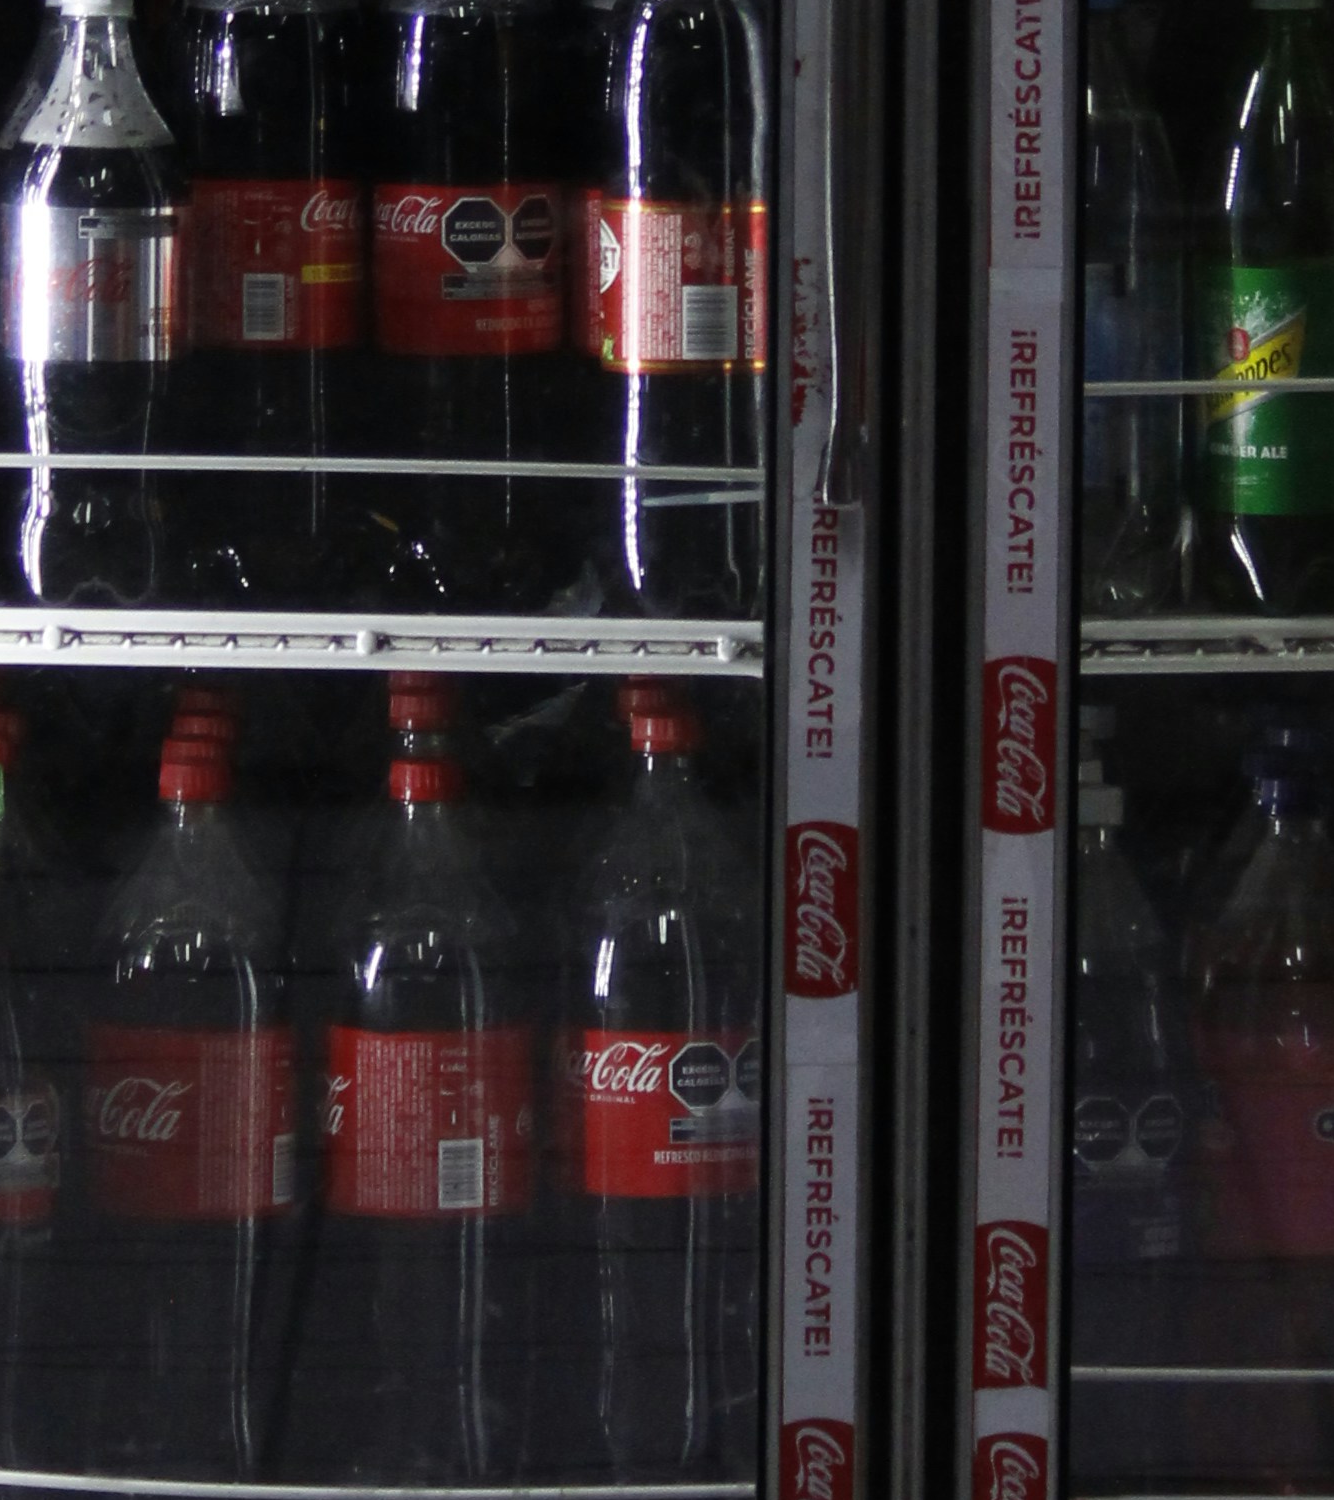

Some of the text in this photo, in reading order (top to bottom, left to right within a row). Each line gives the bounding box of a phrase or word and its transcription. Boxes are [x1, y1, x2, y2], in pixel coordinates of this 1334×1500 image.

[455, 220, 497, 230] EXCESO
[1008, 331, 1038, 593] ¡REFRÉSCATE!
[998, 664, 1047, 822] Coca-Cola
[797, 831, 844, 985] Coca-Cola
